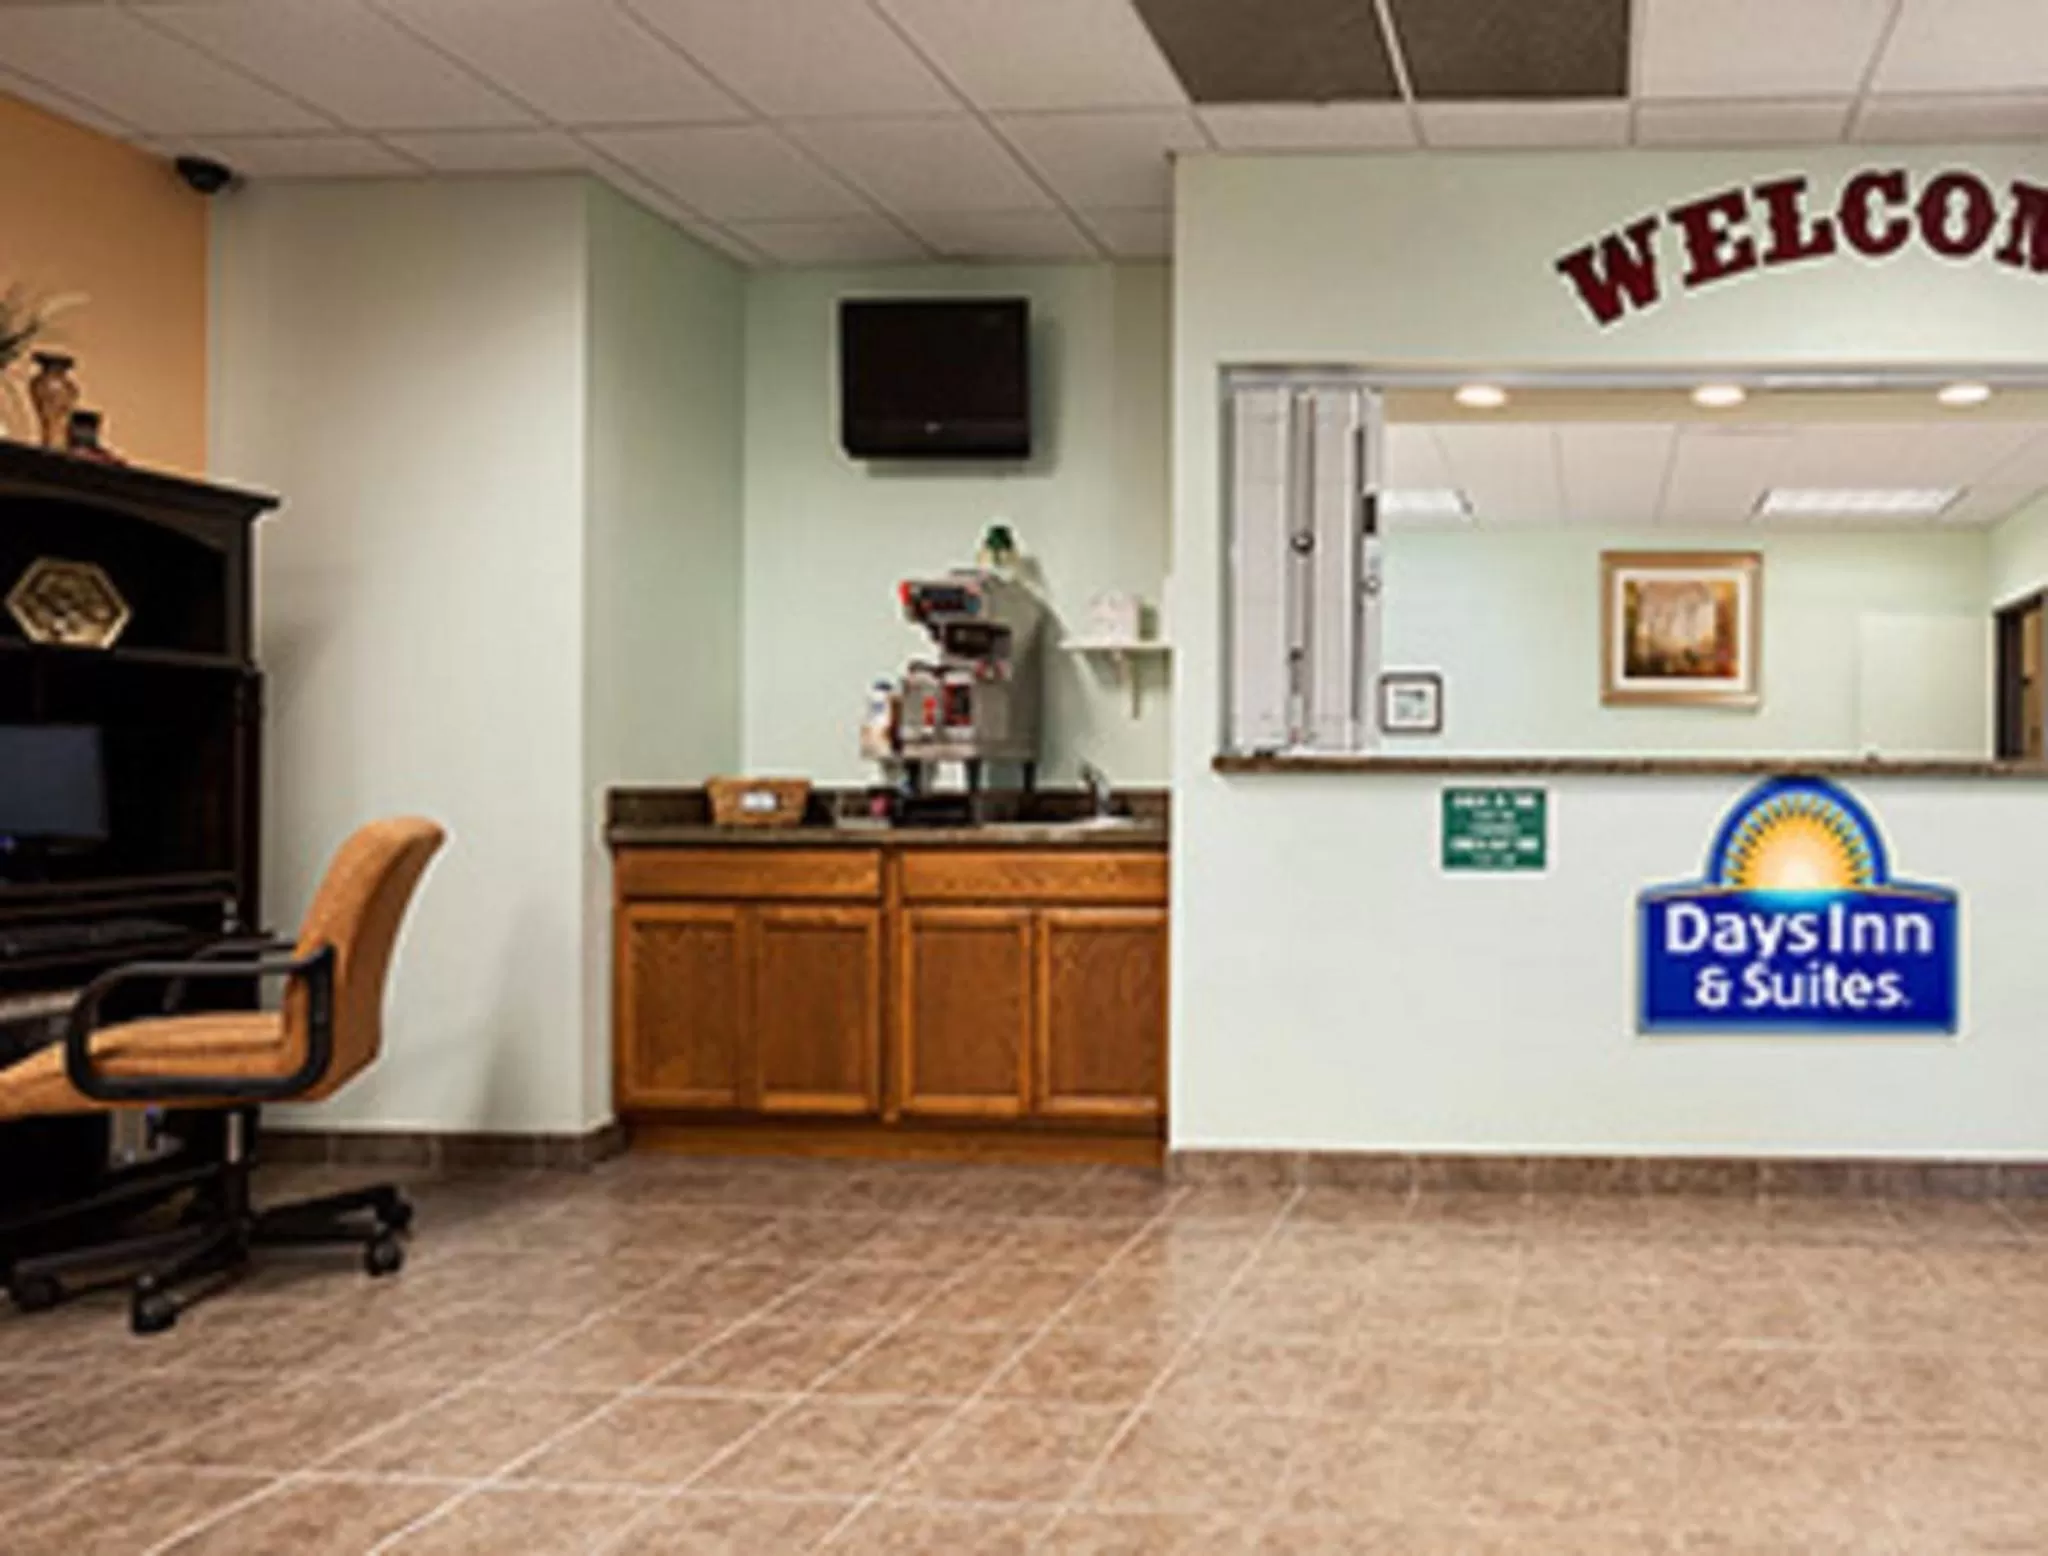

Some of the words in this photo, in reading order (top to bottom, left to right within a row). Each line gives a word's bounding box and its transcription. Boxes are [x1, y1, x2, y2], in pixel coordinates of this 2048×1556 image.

[1664, 902, 1820, 958] Days
[1828, 902, 1934, 953] Inn
[1695, 965, 1732, 1008] &
